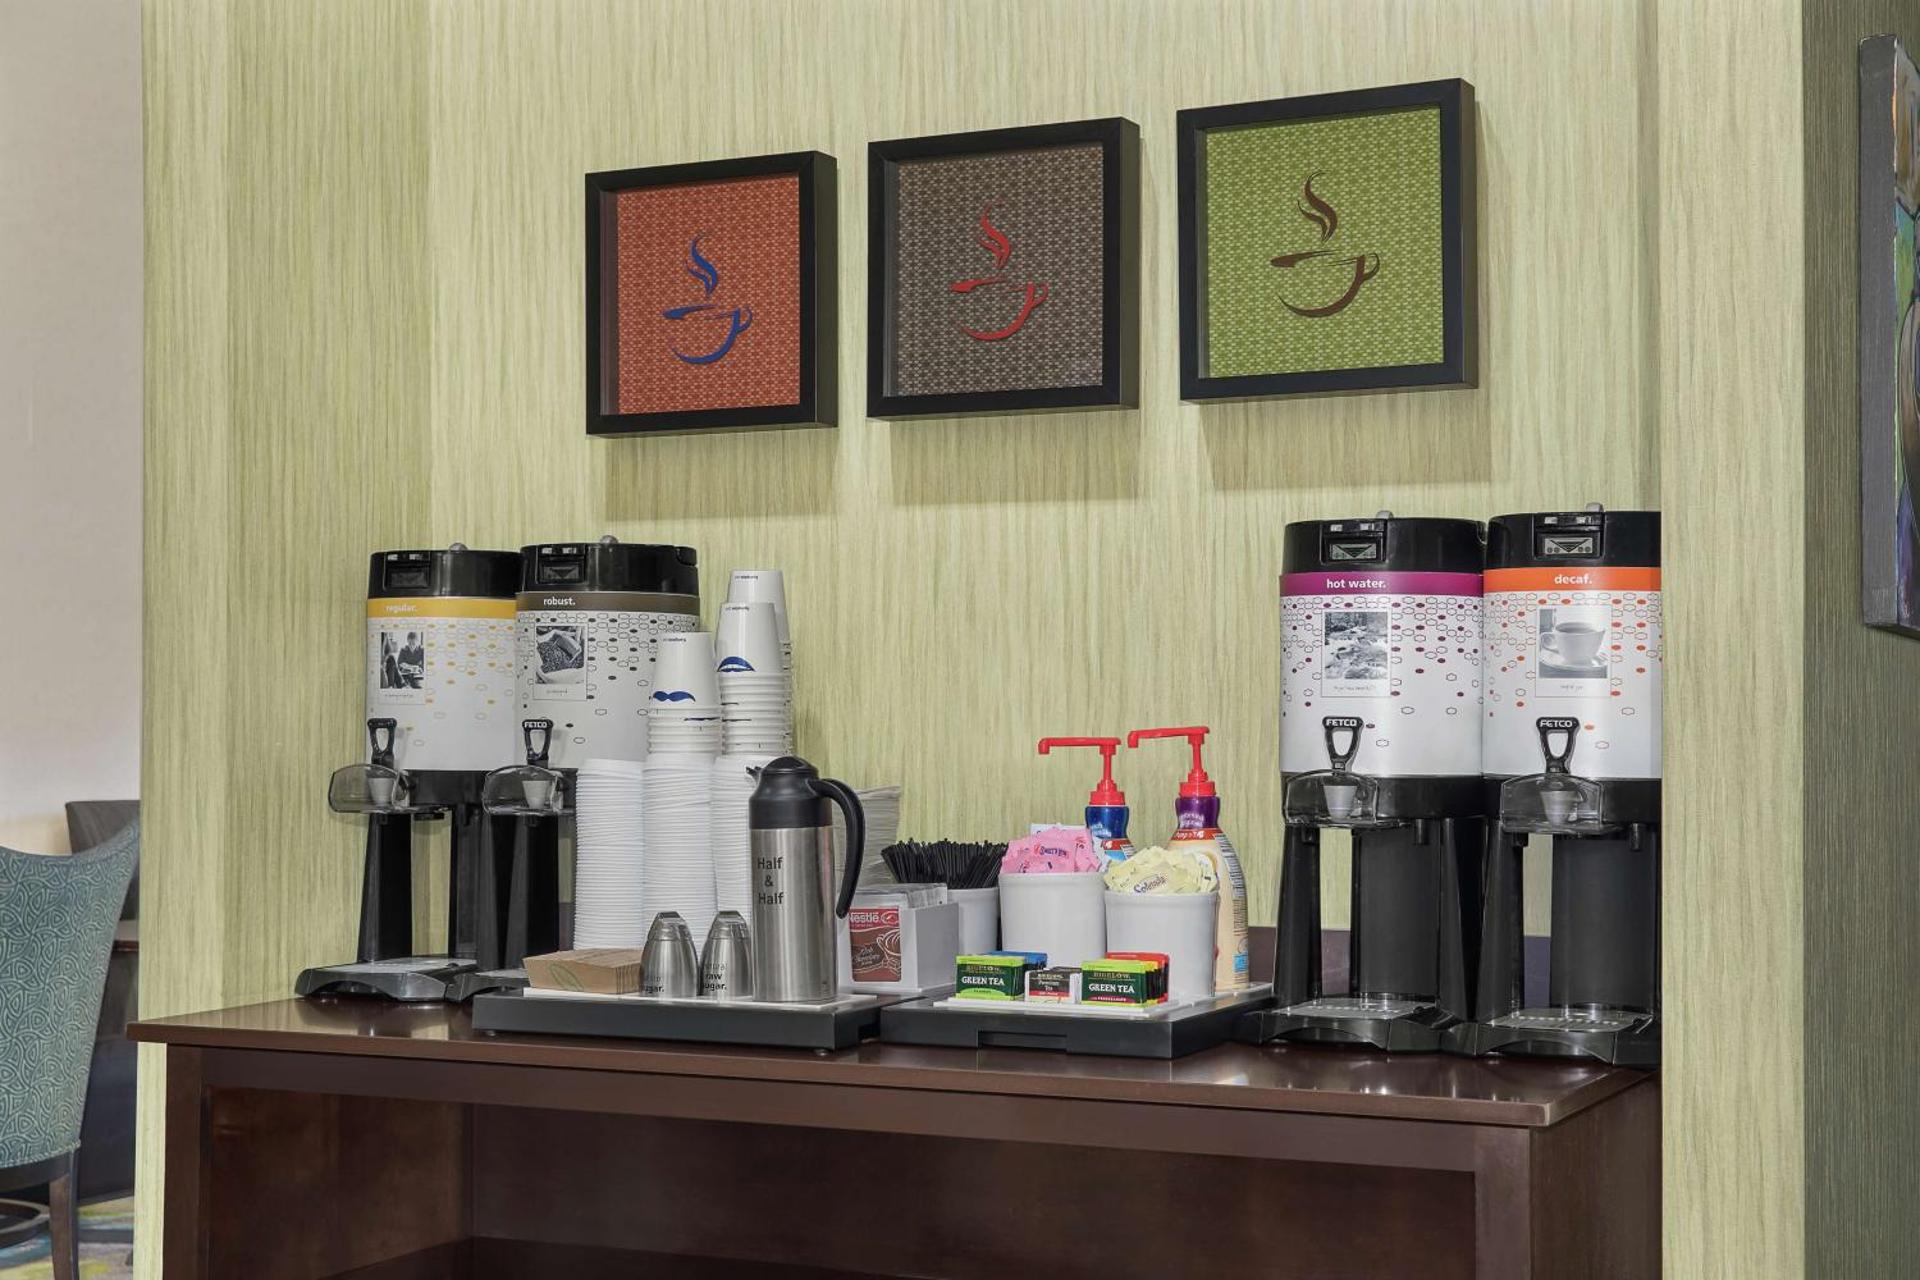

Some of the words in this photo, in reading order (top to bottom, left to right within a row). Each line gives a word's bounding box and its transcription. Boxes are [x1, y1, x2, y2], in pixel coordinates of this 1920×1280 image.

[1326, 578, 1345, 589] hot
[1348, 578, 1387, 589] water.
[1554, 573, 1592, 584] decaf.
[543, 596, 576, 606] robust.
[384, 603, 418, 614] regular.
[1325, 718, 1358, 727] FETCO
[1540, 719, 1573, 728] FETCO
[757, 856, 783, 870] Half
[764, 874, 774, 887] &
[758, 891, 784, 905] Half
[705, 973, 723, 981] raw
[961, 976, 987, 985] GREEN
[988, 977, 1006, 986] TEA
[1088, 983, 1116, 993] GREEN
[1117, 984, 1135, 994] TEA
